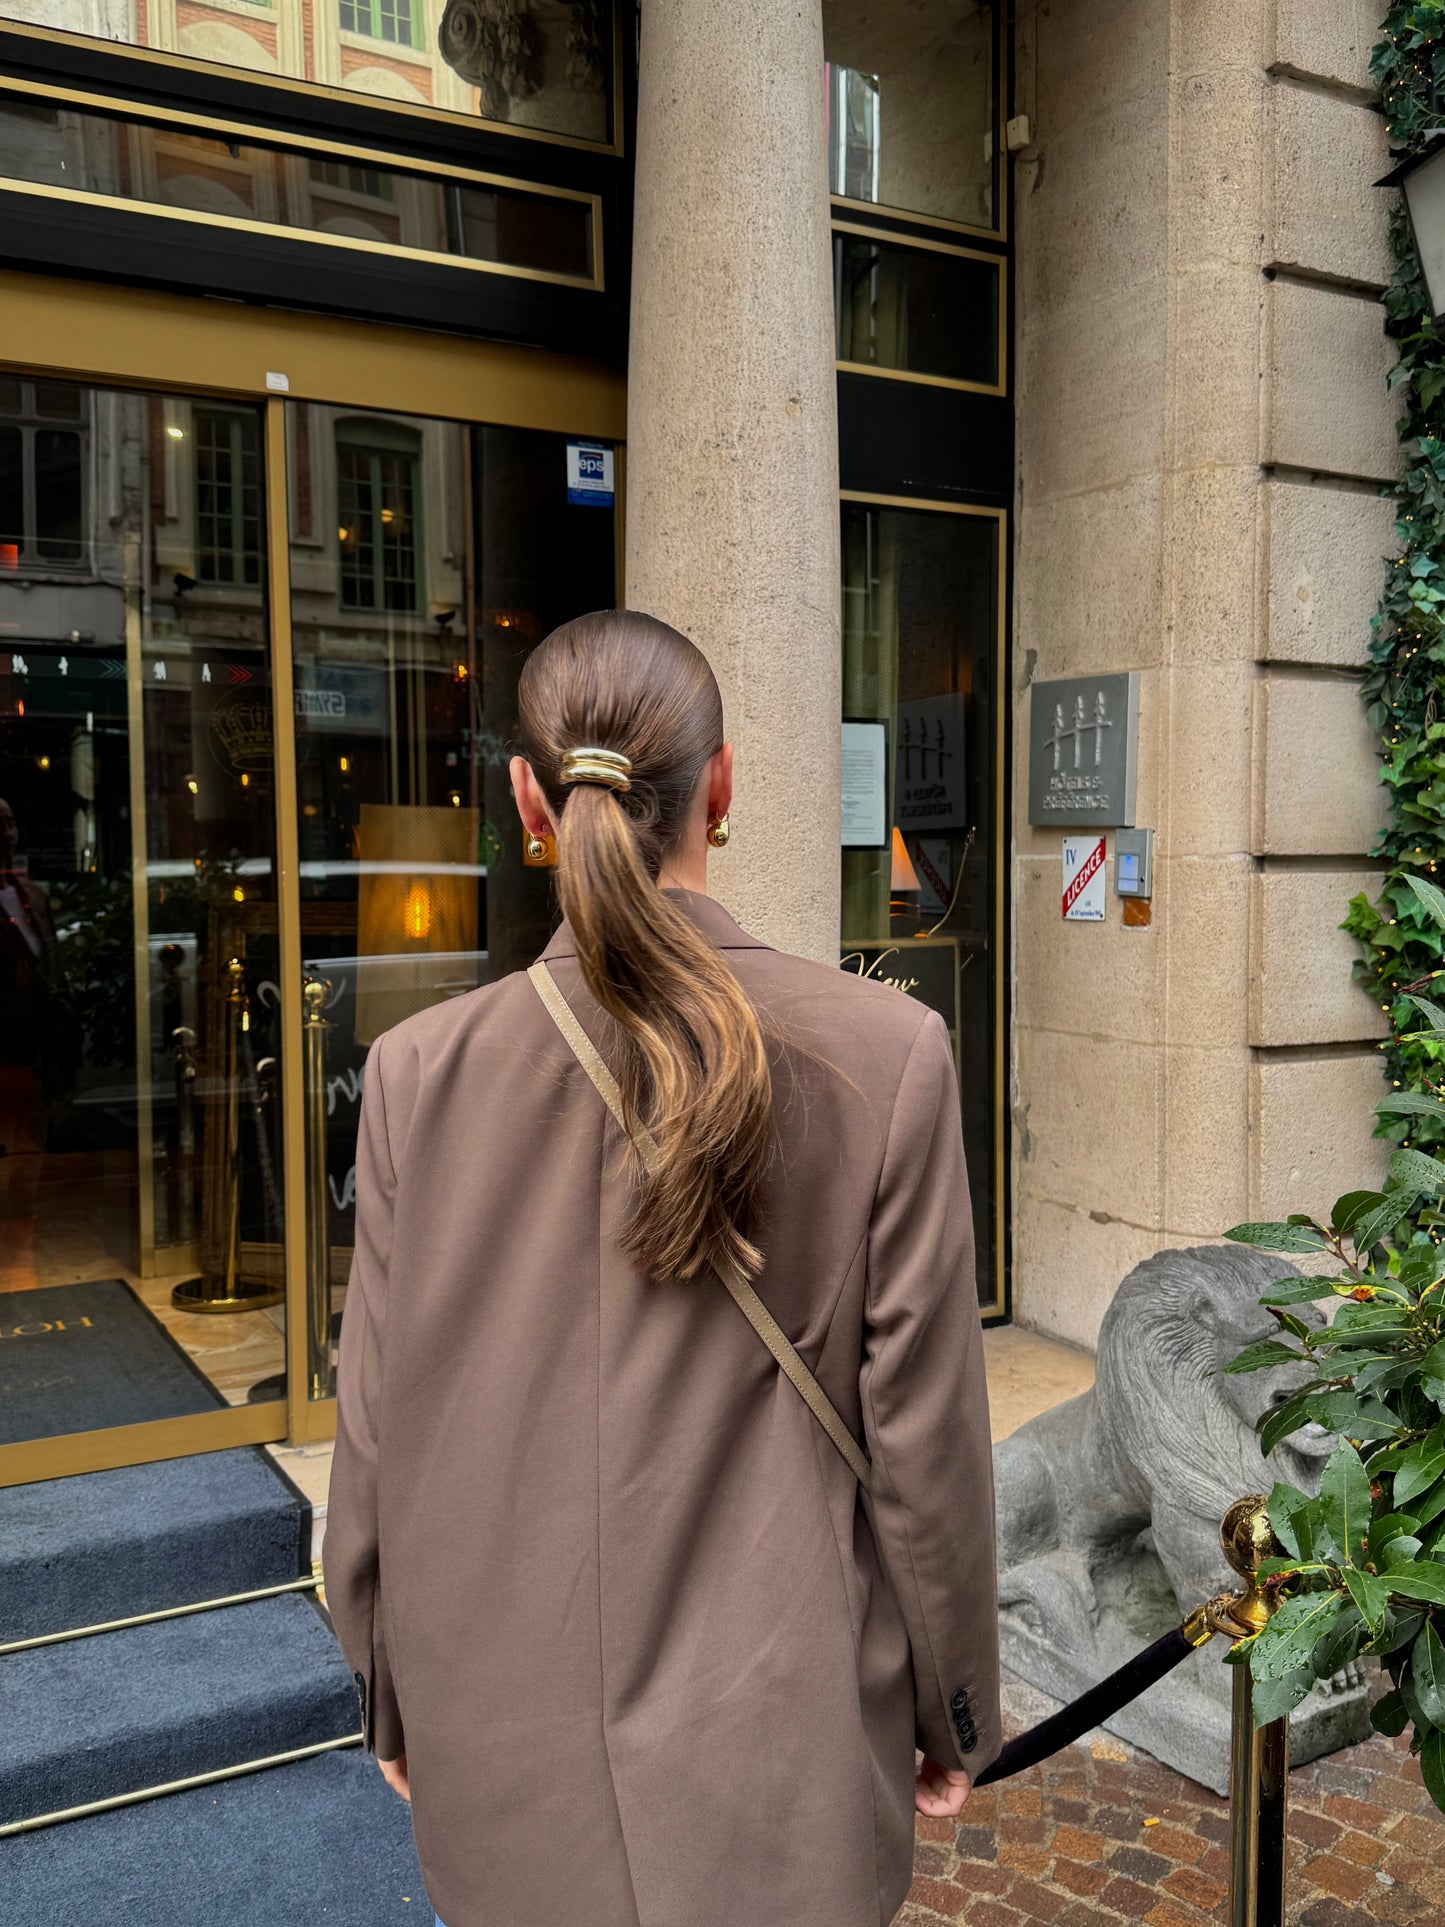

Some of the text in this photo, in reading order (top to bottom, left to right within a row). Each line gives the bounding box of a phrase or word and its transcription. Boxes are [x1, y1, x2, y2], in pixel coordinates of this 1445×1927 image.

[579, 458, 604, 474] eps
[1066, 849, 1076, 865] IV
[1067, 846, 1102, 907] LICENCE
